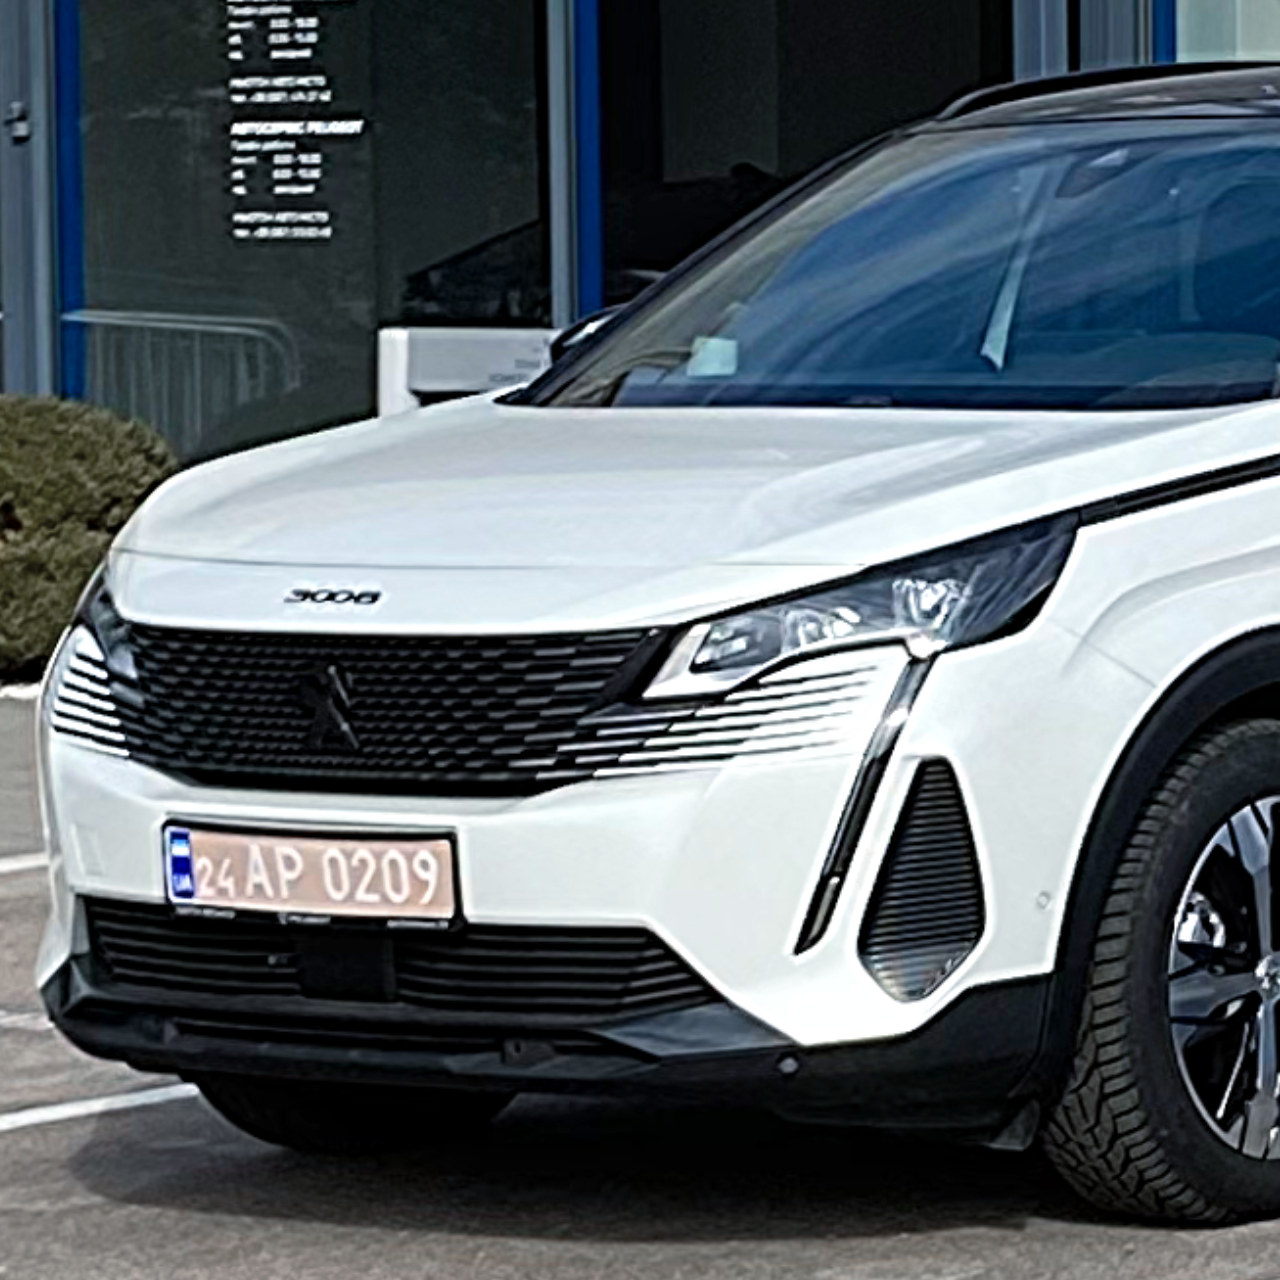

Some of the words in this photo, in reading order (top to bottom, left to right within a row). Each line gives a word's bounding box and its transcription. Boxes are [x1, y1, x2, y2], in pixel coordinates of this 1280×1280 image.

[196, 857, 236, 898] 24
[245, 844, 304, 900] AP
[322, 847, 438, 904] 0209
